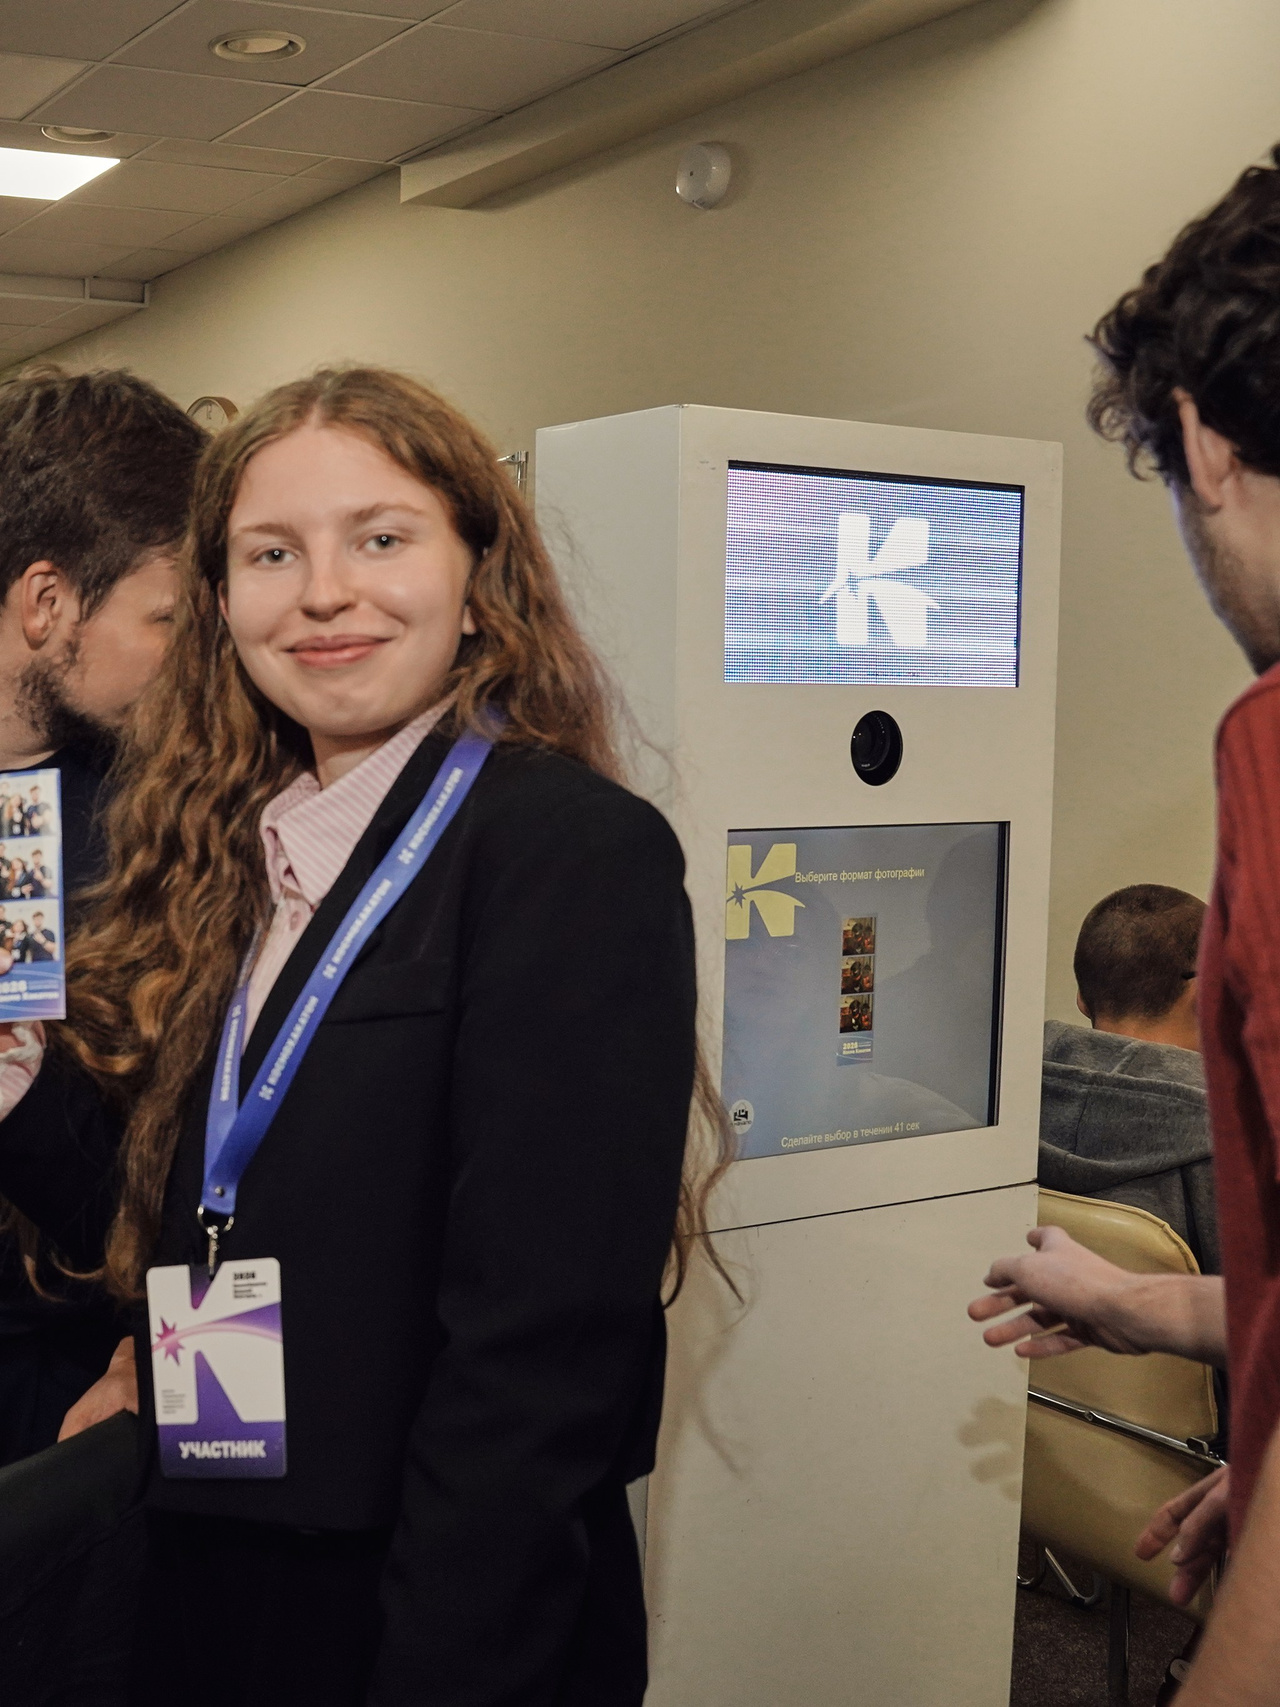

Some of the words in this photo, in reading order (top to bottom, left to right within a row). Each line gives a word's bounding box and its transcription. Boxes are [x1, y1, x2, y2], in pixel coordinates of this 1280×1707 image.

[795, 871, 838, 884] Выберите
[840, 870, 873, 882] формат
[874, 867, 925, 881] фотографии
[781, 1133, 823, 1148] Сделайте
[824, 1130, 851, 1142] выбор
[853, 1130, 859, 1139] в
[860, 1125, 892, 1137] течении
[894, 1122, 904, 1132] 41
[906, 1121, 920, 1131] сек
[178, 1439, 267, 1459] УЧАСТНИК
